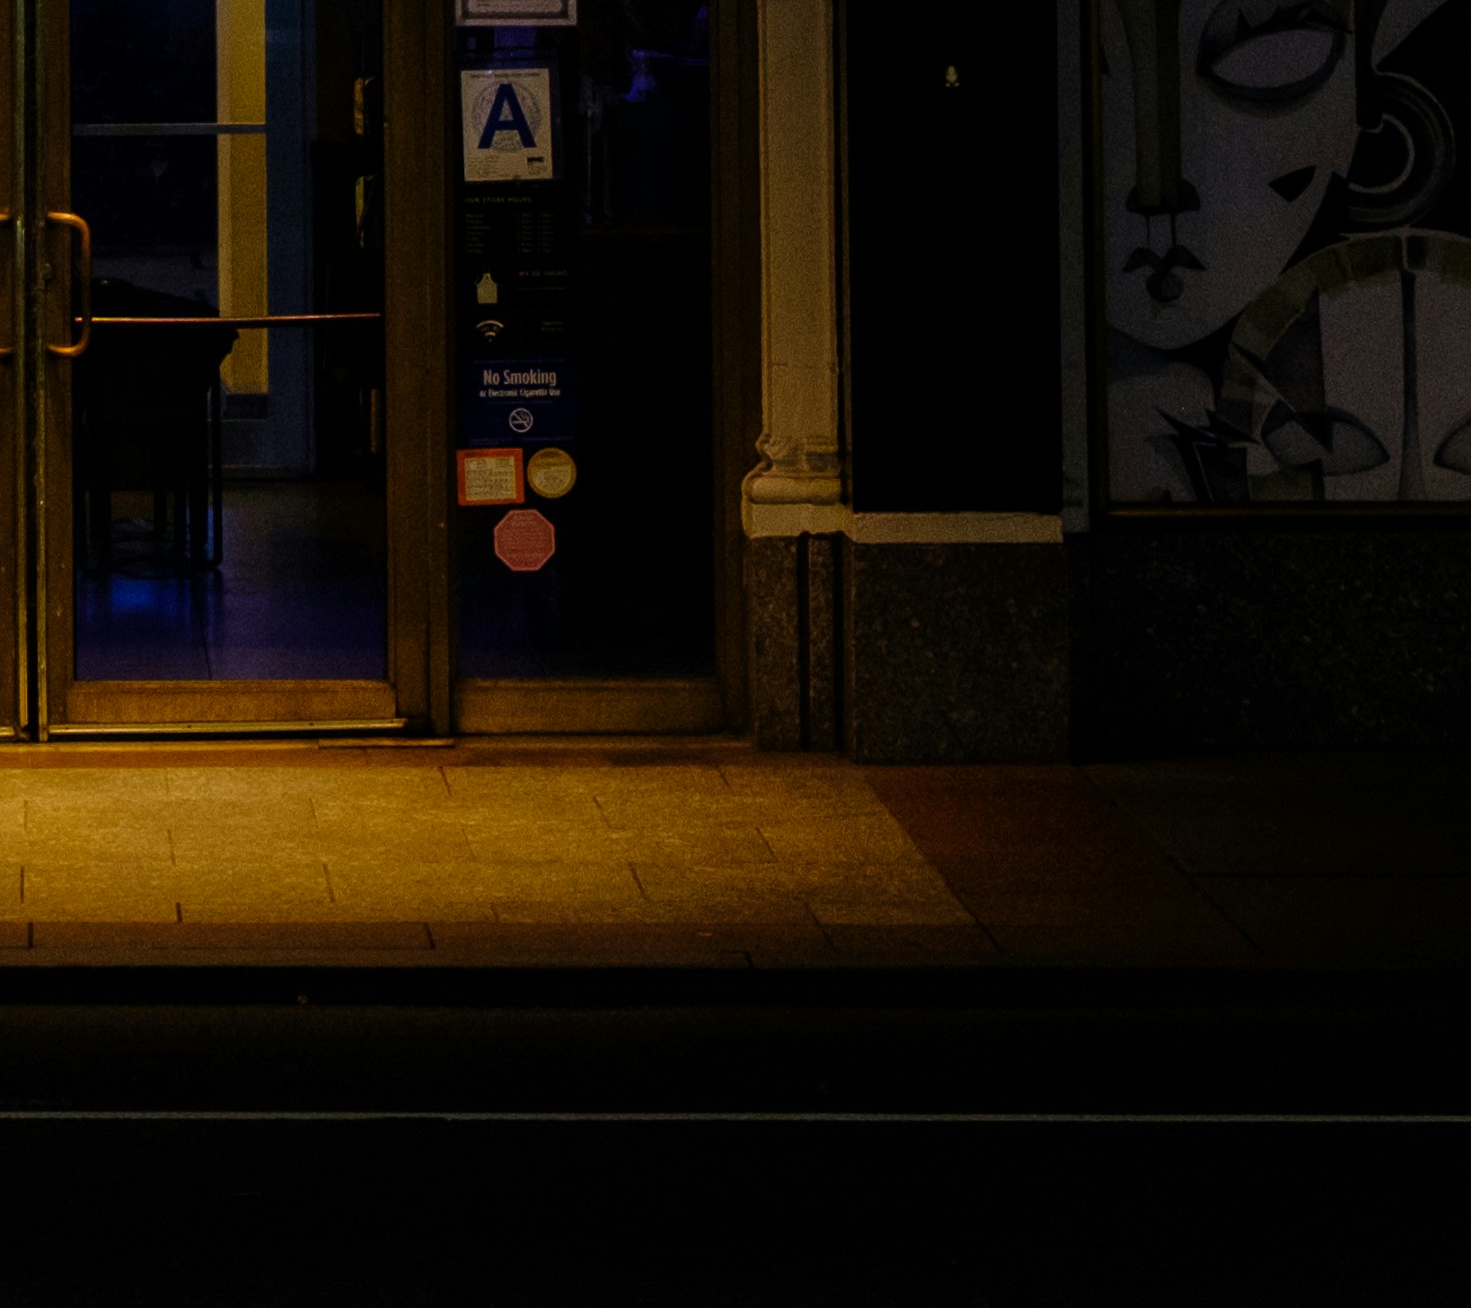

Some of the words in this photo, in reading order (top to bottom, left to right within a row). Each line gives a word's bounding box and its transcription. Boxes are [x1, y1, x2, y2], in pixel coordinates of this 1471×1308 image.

[478, 84, 536, 148] A
[483, 369, 500, 385] No
[504, 368, 557, 387] Smoking
